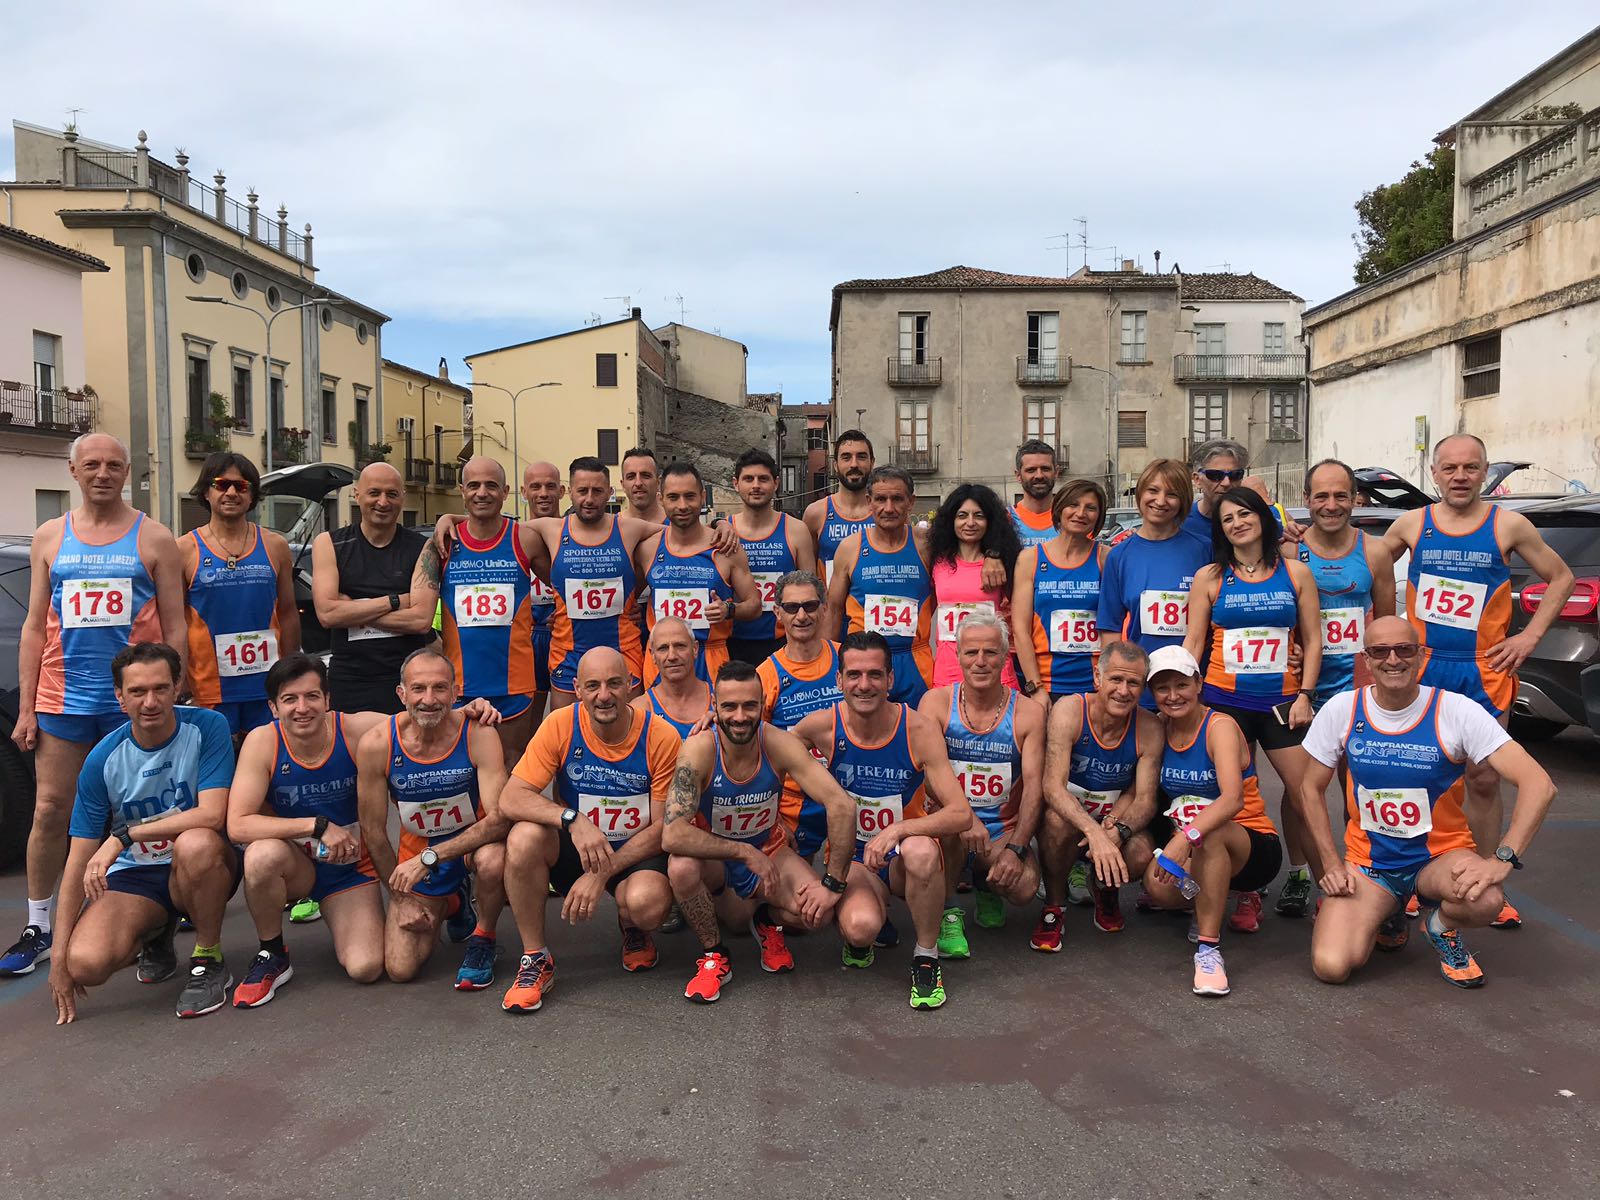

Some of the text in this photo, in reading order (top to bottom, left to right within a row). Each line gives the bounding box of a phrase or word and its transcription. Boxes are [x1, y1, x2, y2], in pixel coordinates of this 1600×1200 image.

[828, 523, 876, 538] NEW GA
[58, 554, 136, 566] GRAND HOTEL LAMEZIA
[563, 548, 621, 557] SPORTGLASS
[1422, 549, 1492, 563] GRAND HOTEL LAMEZIA
[216, 564, 270, 573] SANRANCESCO
[449, 559, 518, 570] DUOMO UniOne
[665, 565, 714, 573] SANFRANCESCO
[862, 565, 920, 576] GRAND HOTEL LAMEZIA
[755, 582, 776, 602] 62
[1038, 581, 1057, 590] GRAND
[1057, 581, 1076, 590] HOTEL
[69, 591, 123, 616] 178
[461, 594, 507, 617] 183
[572, 588, 617, 610] 167
[1224, 593, 1248, 604] GRAND
[1248, 592, 1271, 603] HOTEL
[1423, 587, 1475, 618] 152
[660, 598, 703, 620] 182
[870, 605, 912, 627] 154
[1147, 602, 1189, 626] 181
[1057, 620, 1099, 643] 158
[1326, 619, 1359, 644] 84
[224, 640, 269, 666] 161
[1231, 639, 1281, 663] 177
[780, 689, 821, 705] DUOMO
[964, 739, 985, 751] HOTEL
[985, 741, 1013, 756] LAMEZIA
[1364, 746, 1440, 763] INFISSI
[1365, 740, 1438, 753] SANFRANCESCO
[407, 767, 473, 780] SANFRANCESCO
[584, 764, 648, 781] SANFRANCESCO
[856, 765, 913, 780] PREMAC
[1165, 767, 1217, 781] PREMAC
[957, 773, 1004, 797] 156
[713, 790, 772, 806] EDIL TRICHILO
[1084, 799, 1113, 816] 75
[1365, 800, 1421, 827] 169
[409, 805, 463, 830] 171
[587, 807, 641, 831] 173
[719, 808, 771, 831] 172
[859, 808, 894, 832] 60
